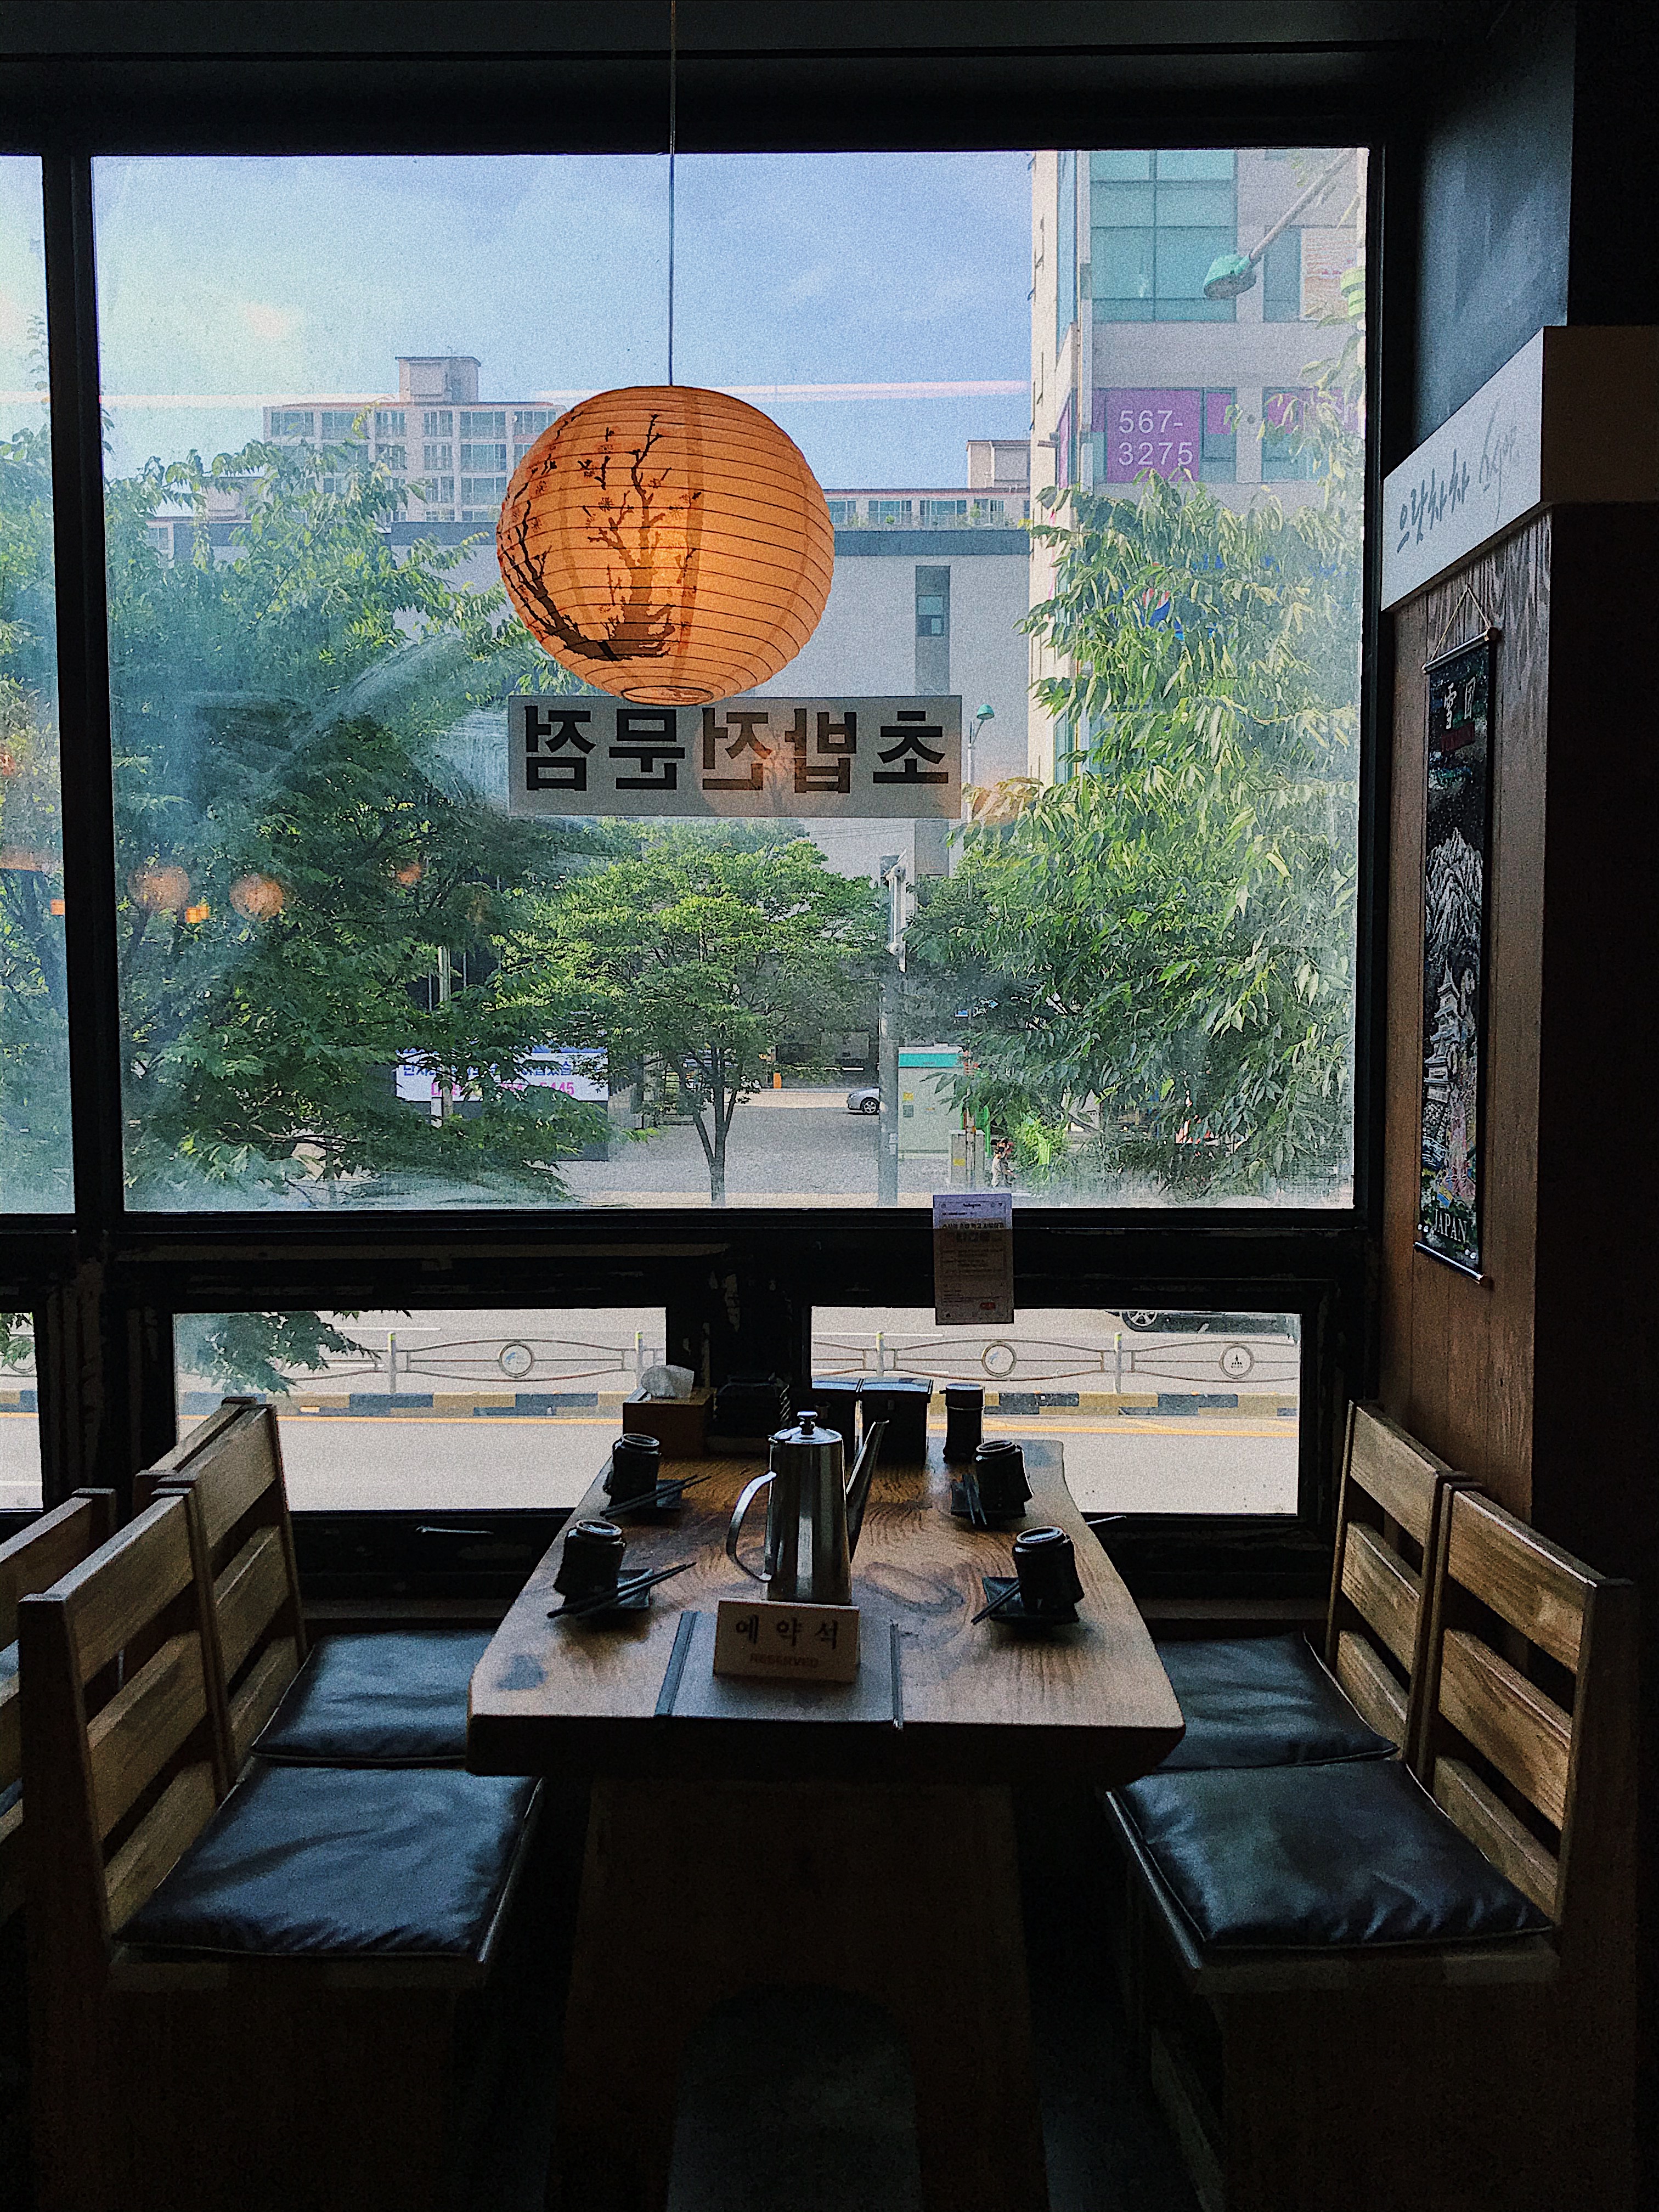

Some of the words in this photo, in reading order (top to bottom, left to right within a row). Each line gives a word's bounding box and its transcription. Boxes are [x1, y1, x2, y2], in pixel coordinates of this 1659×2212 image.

[1119, 410, 1183, 433] 567-
[1119, 442, 1193, 466] 3275
[1431, 1209, 1468, 1244] JAPAN
